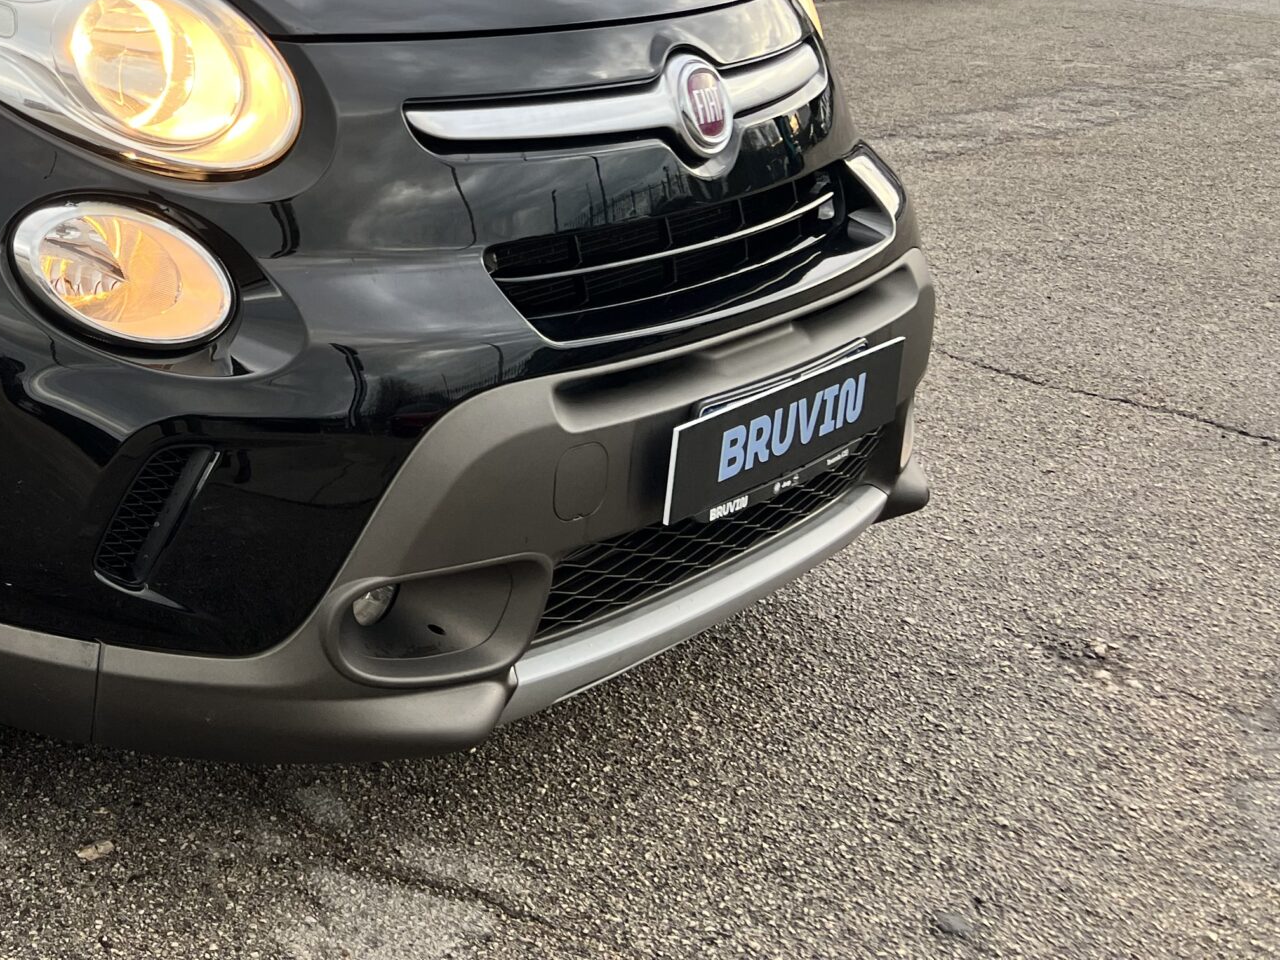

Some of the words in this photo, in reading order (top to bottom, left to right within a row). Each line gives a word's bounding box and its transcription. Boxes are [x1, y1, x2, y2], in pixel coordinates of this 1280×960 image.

[692, 87, 724, 125] FIAT
[717, 372, 867, 483] BRUVIN
[709, 495, 749, 522] BRUVIN
